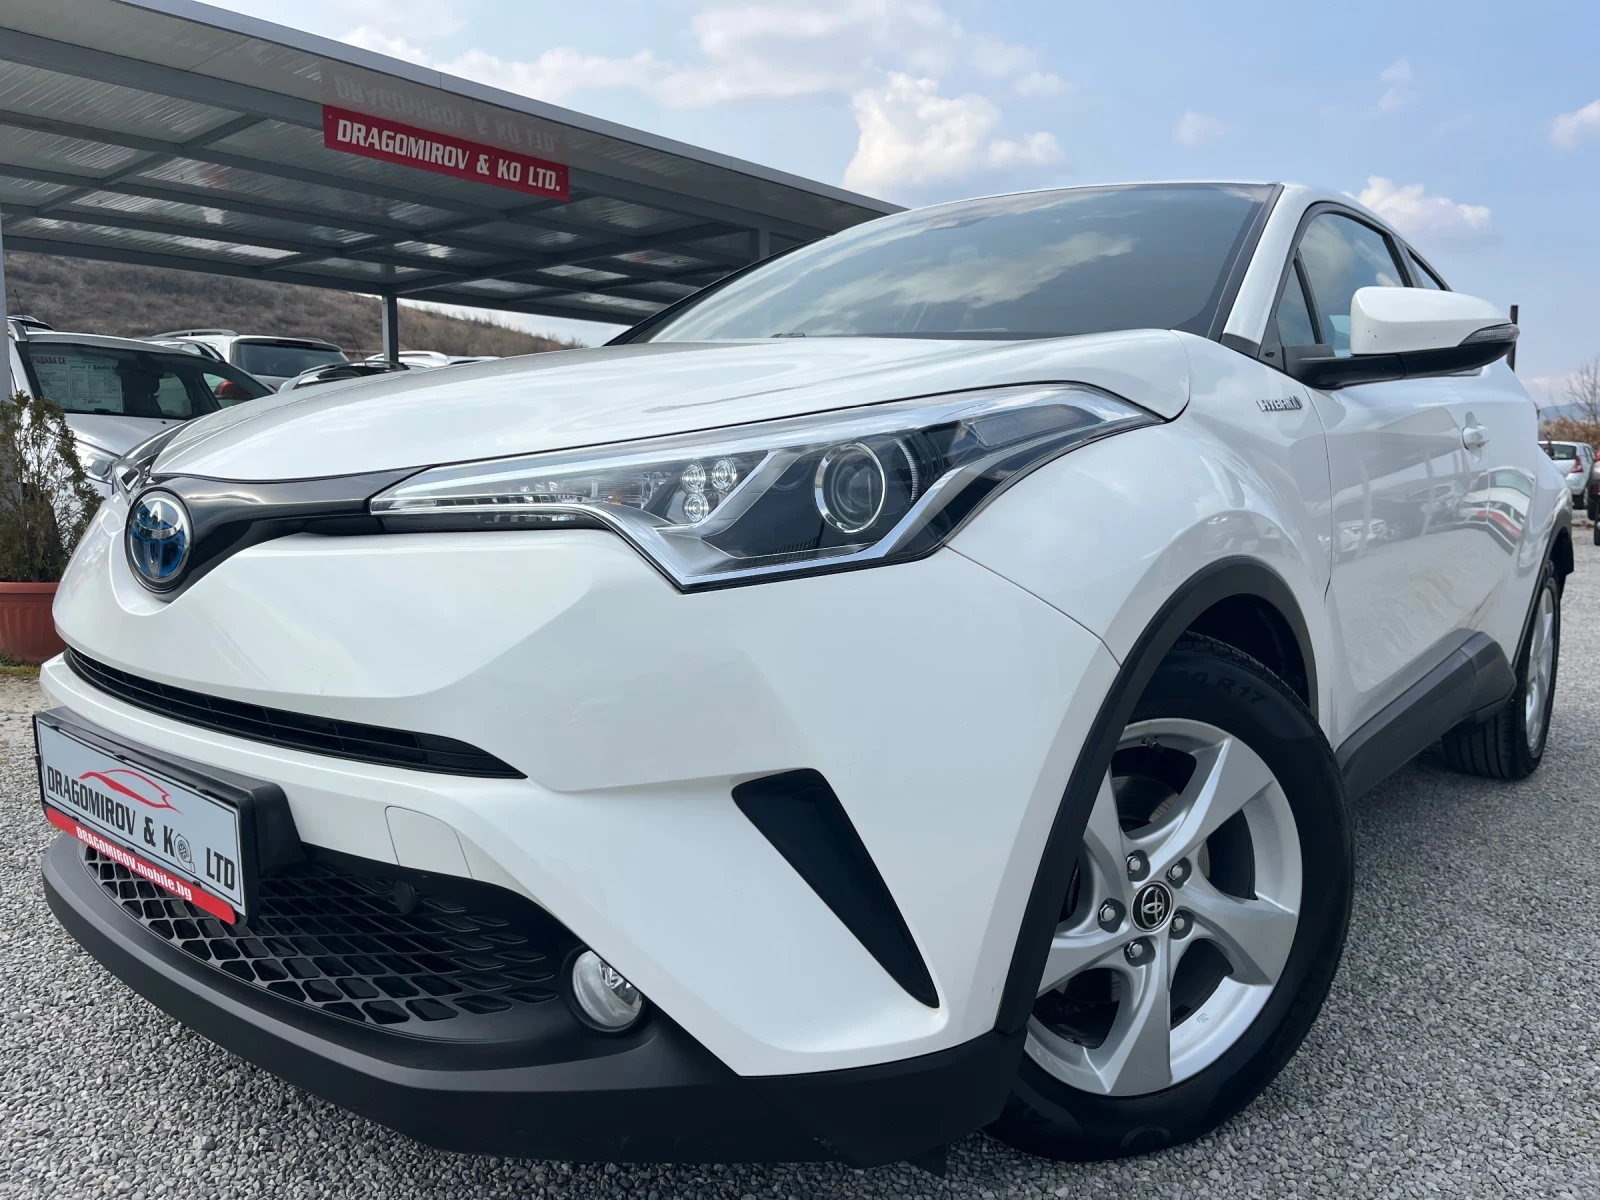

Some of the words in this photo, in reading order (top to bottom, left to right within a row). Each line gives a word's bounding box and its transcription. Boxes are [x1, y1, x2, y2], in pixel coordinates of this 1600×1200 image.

[337, 118, 470, 170] DRAGOMIROV
[476, 153, 490, 176] &
[497, 157, 521, 182] KO
[528, 165, 561, 192] LTD.
[47, 765, 136, 836] DRAGOMIROV
[143, 816, 157, 848] &
[206, 847, 236, 892] LTD
[75, 825, 193, 901] DRAGOMIROV.mobile.bg
